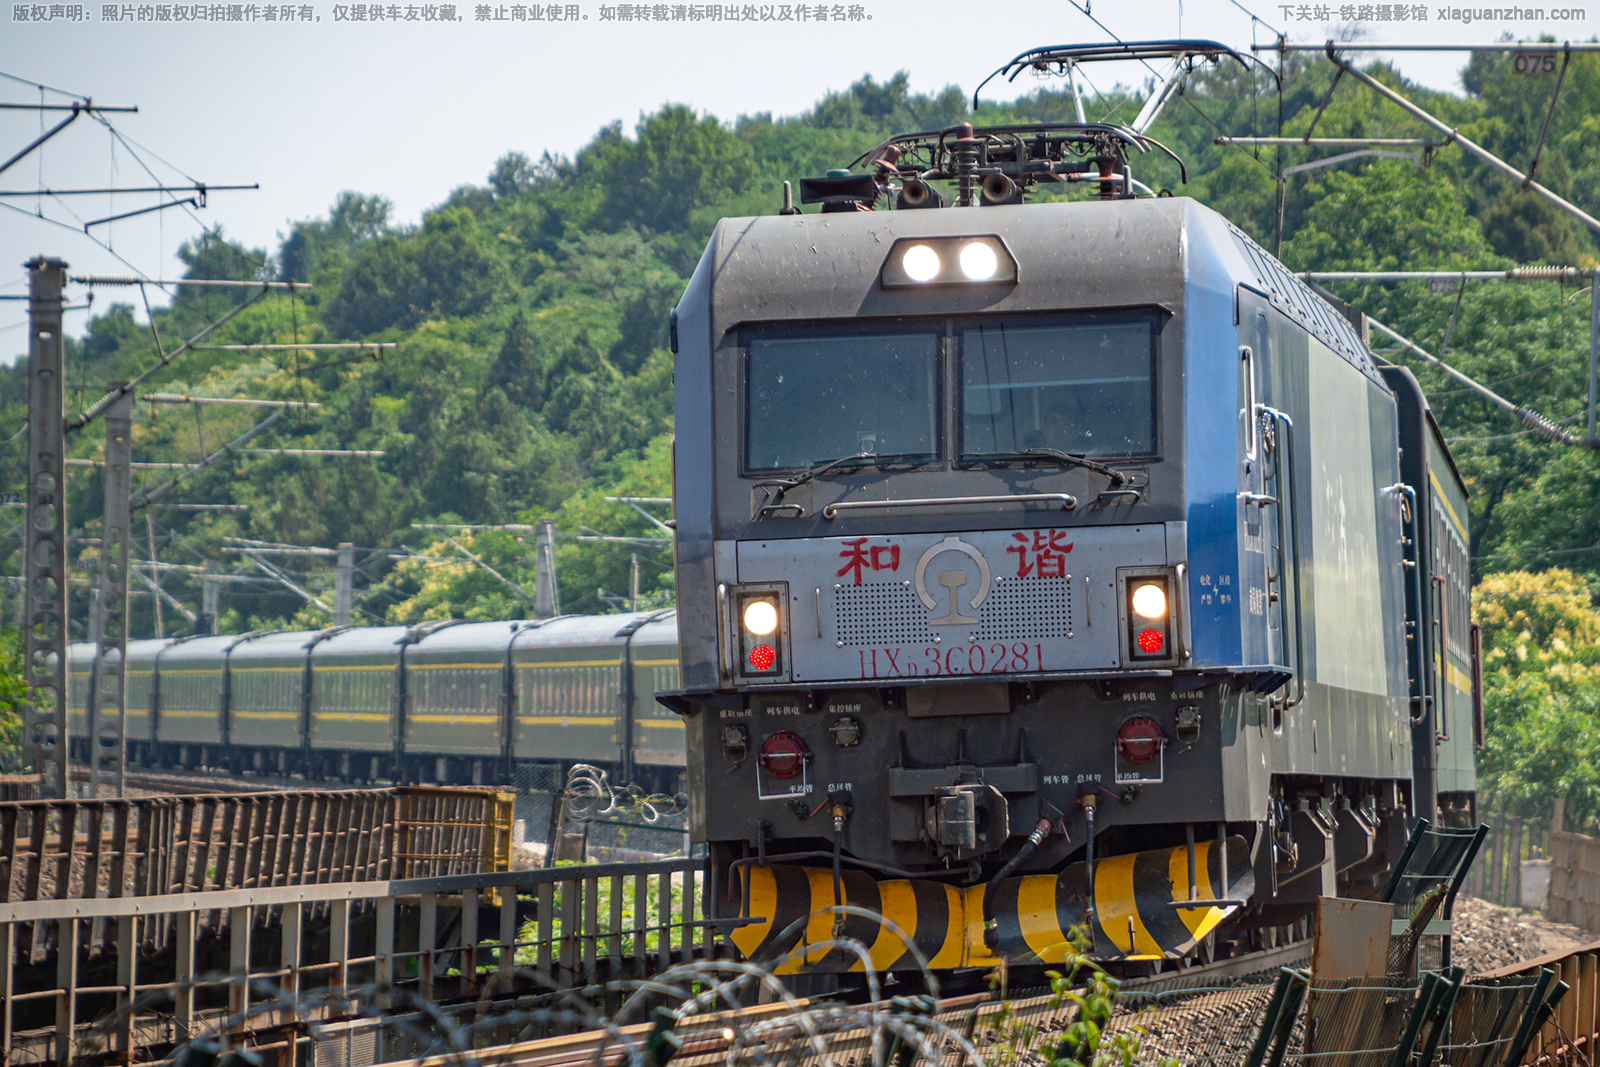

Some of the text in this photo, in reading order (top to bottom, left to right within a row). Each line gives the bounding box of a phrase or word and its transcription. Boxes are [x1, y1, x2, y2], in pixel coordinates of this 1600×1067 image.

[1514, 55, 1555, 73] 075
[834, 529, 1073, 586] 和 谐
[766, 706, 800, 716] 列车供电
[1043, 775, 1069, 784] 列车管
[828, 782, 852, 793] 总风管
